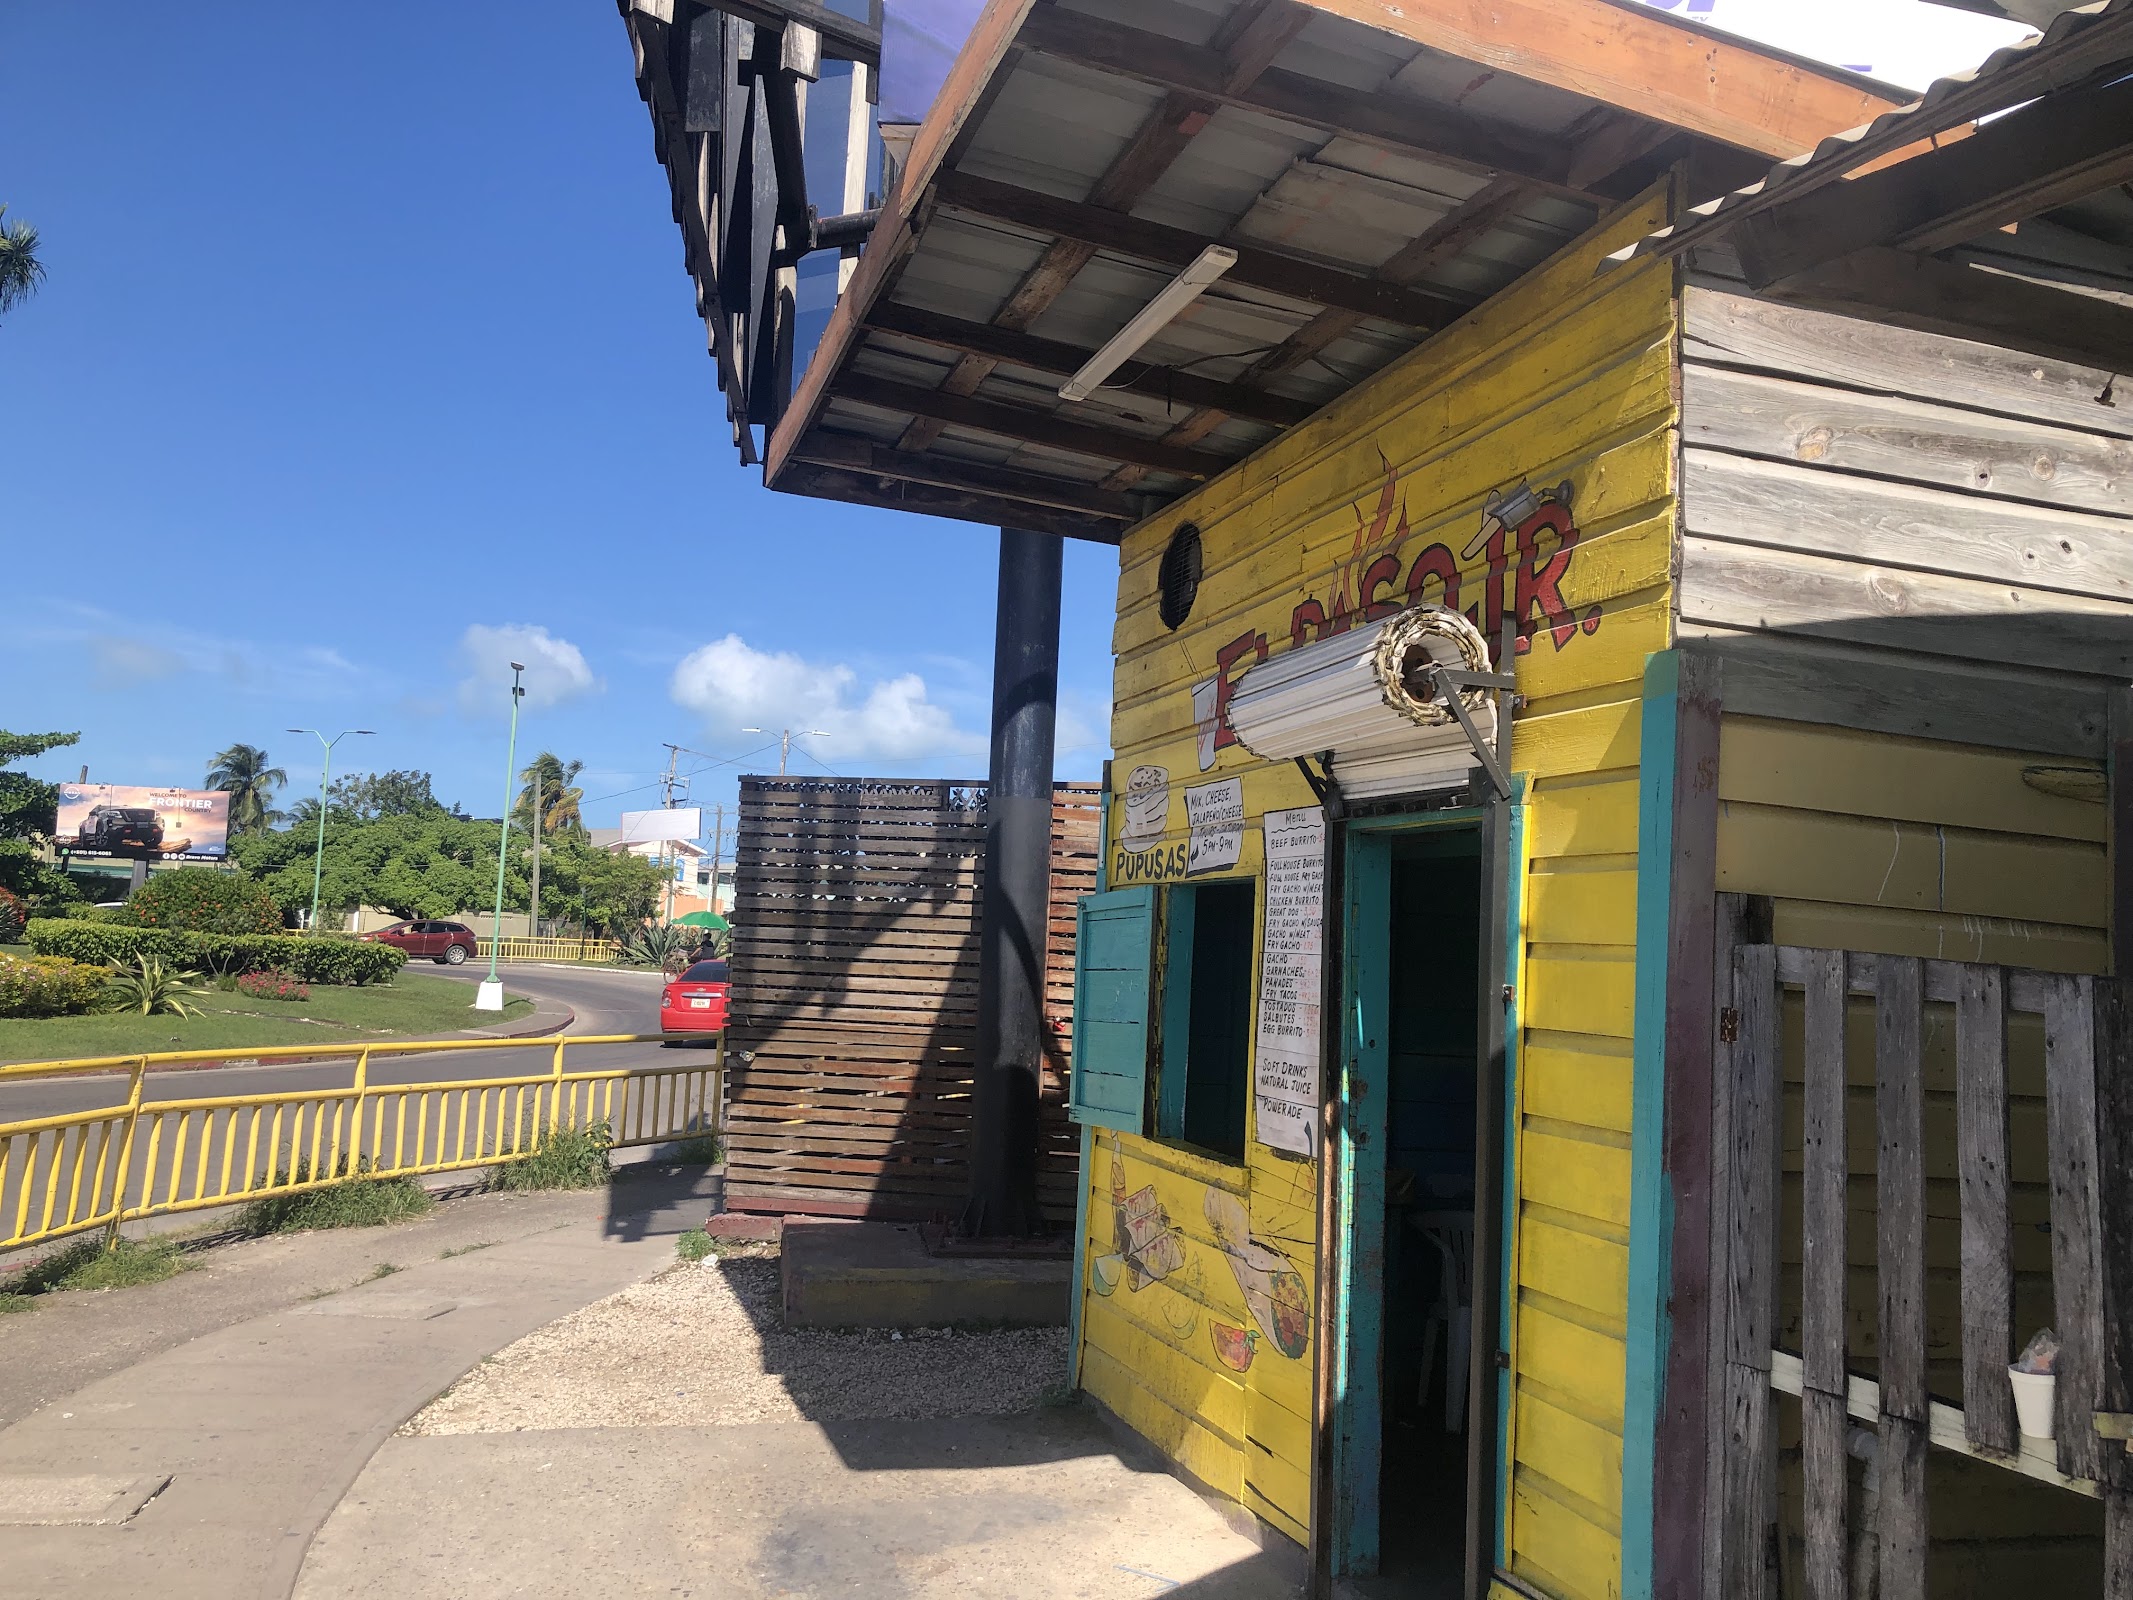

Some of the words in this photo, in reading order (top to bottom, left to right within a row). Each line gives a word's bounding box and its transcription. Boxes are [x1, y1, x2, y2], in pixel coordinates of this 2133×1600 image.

[149, 797, 212, 808] FRONTIER
[1271, 838, 1288, 849] BEEF
[1290, 834, 1316, 846] BURRITO
[1116, 844, 1186, 881] PUPUSAS
[1270, 885, 1281, 894] FRY
[1283, 884, 1301, 893] GACHO
[1270, 896, 1293, 905] CHICKEN
[1294, 895, 1320, 905] BURRITO
[1269, 907, 1287, 916] GREAT
[1288, 907, 1299, 916] DOG
[1268, 919, 1280, 928] FRY
[1282, 919, 1300, 928] GACHO
[1268, 929, 1287, 938] GACHO
[1267, 940, 1280, 950] FRY
[1280, 940, 1301, 950] GACHO
[1267, 954, 1288, 964] GACHO
[1265, 978, 1293, 989] PANADES
[1266, 989, 1277, 998] FRY
[1280, 990, 1298, 1000] TACOS
[1264, 1001, 1296, 1013] TOSTADOS
[1264, 1012, 1295, 1024] SALBUTES
[1263, 1023, 1275, 1034] EGG
[1278, 1024, 1303, 1037] BURRITO
[1263, 1058, 1280, 1073] SOFT
[1282, 1062, 1308, 1078] DRINKS
[1261, 1075, 1288, 1090] NATURAL
[1291, 1080, 1311, 1094] JUICE
[1263, 1098, 1302, 1119] POWERADE
